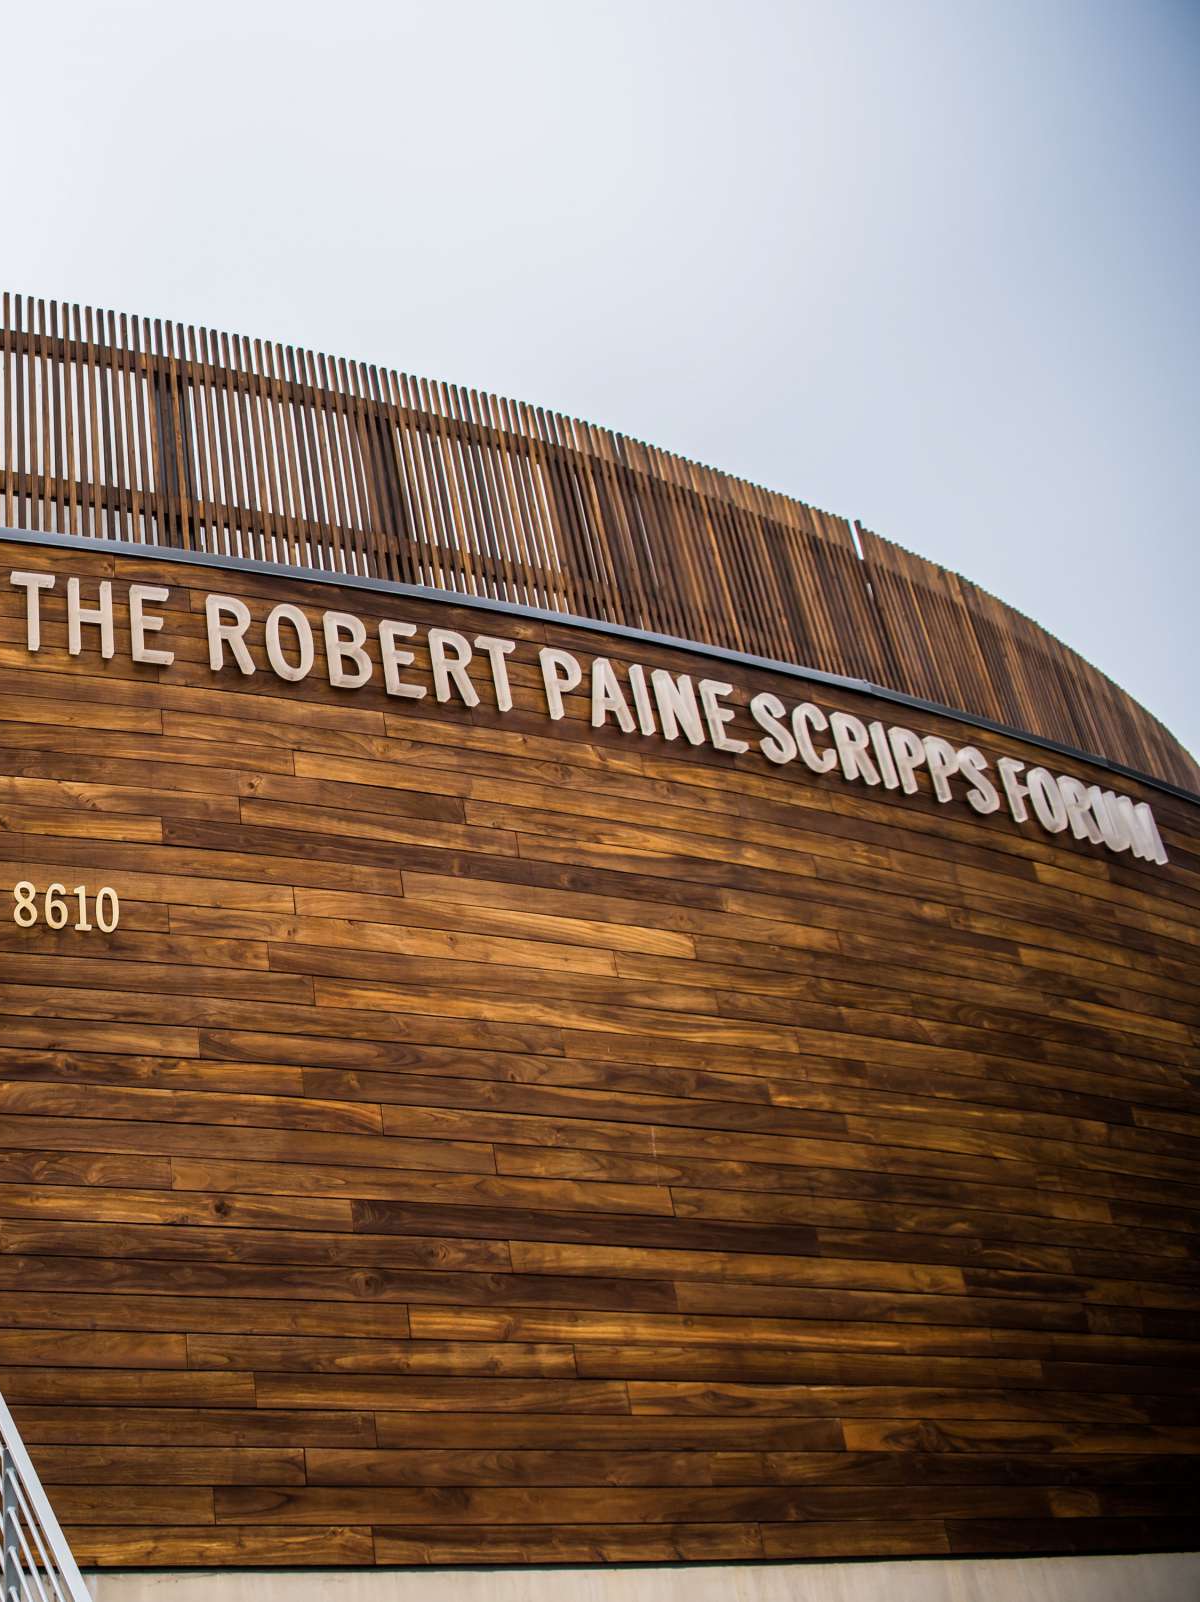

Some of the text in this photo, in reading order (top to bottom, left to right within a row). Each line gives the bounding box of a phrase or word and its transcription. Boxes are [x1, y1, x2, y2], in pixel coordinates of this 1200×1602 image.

[10, 571, 1169, 866] THE ROBERT PAINE SCRIPPS FORUM
[13, 880, 119, 933] 8610
